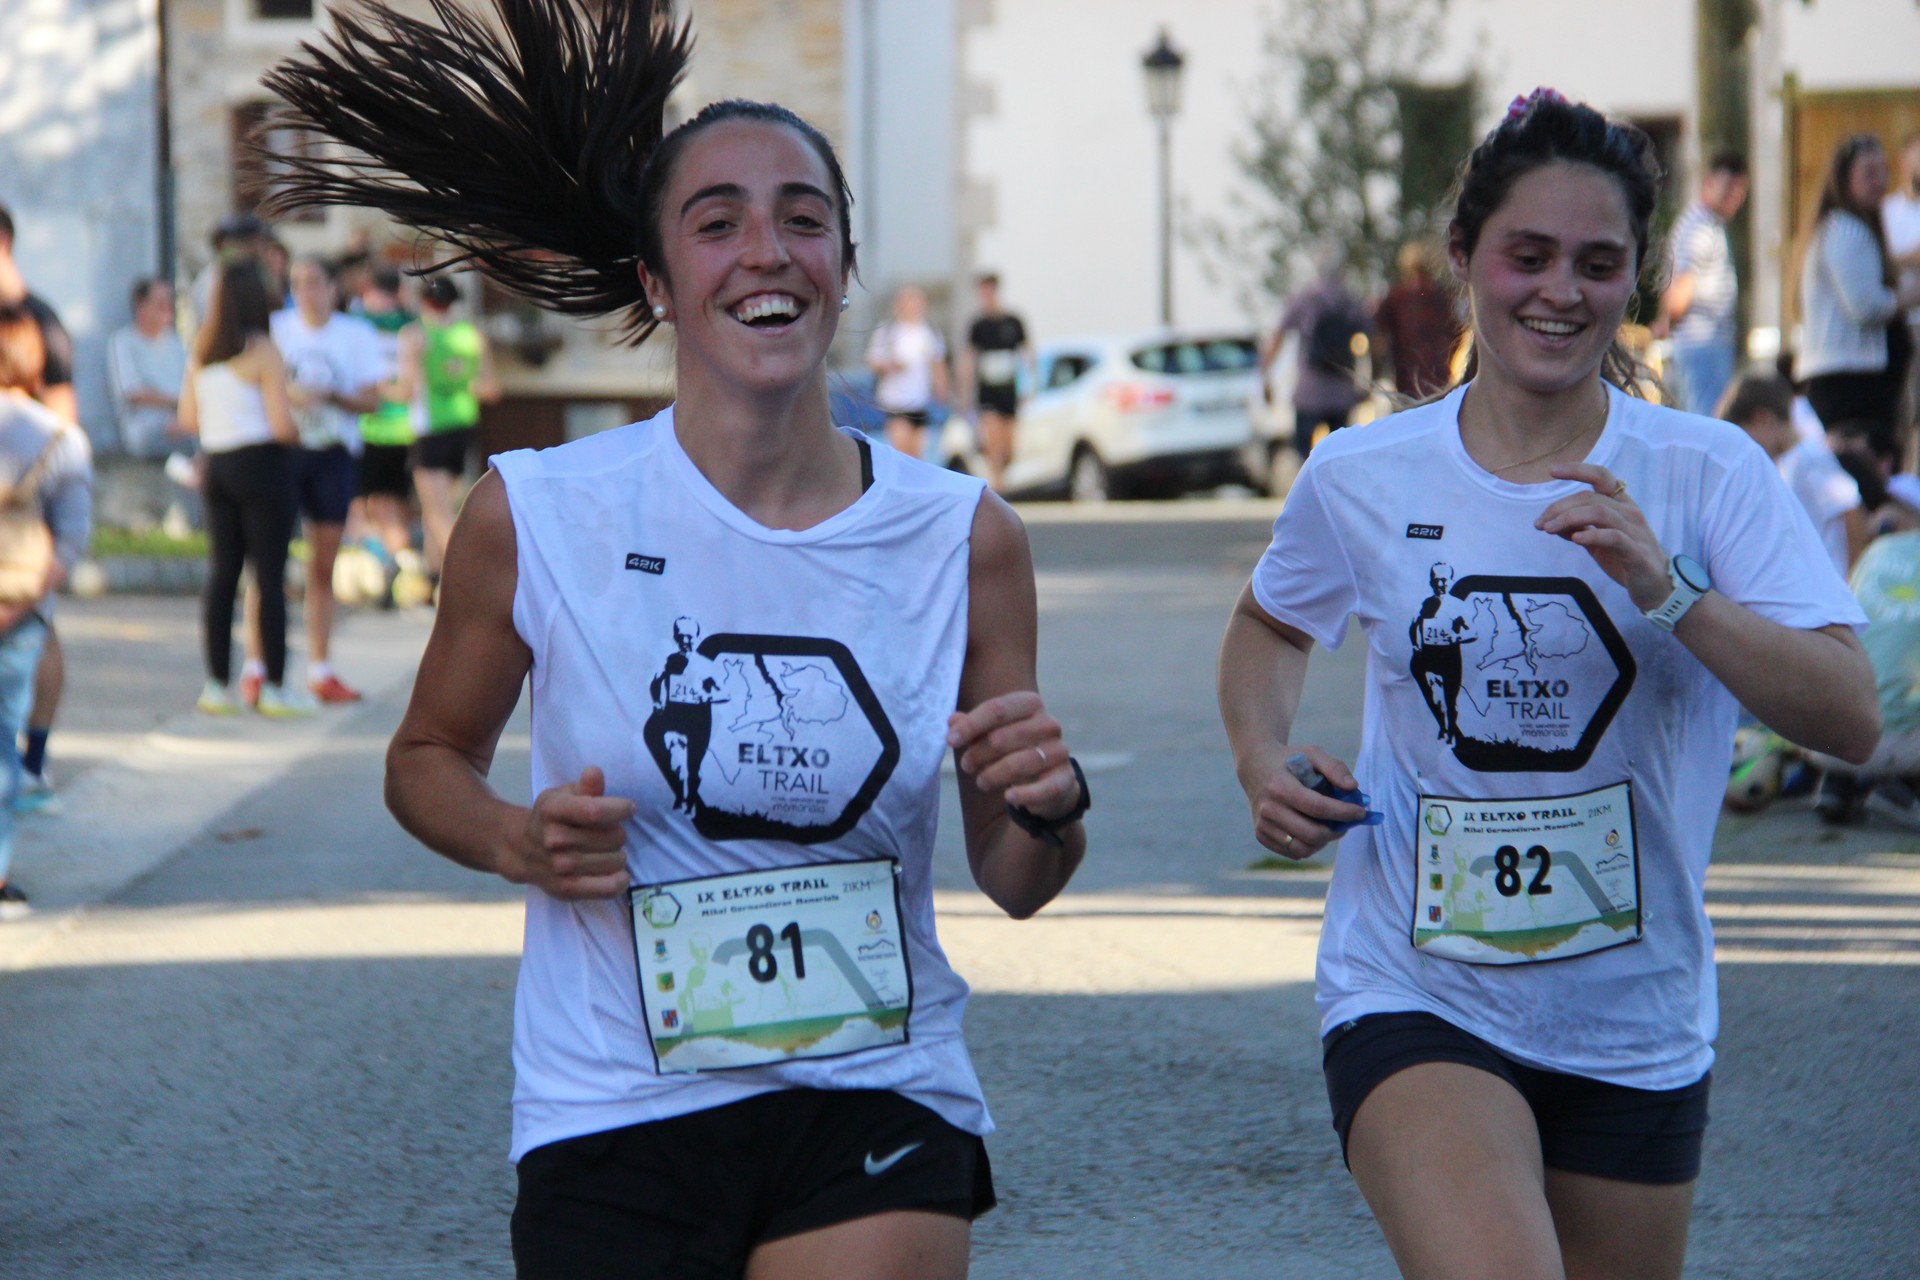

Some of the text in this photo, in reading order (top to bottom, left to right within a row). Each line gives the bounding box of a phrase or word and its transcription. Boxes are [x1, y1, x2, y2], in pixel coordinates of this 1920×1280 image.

[1409, 527, 1440, 537] 42K
[628, 557, 661, 571] 42K
[1487, 679, 1570, 699] ELTXO
[1506, 701, 1570, 719] TRAIL
[738, 742, 830, 769] ELTXO
[758, 769, 830, 795] TRAIL
[1464, 811, 1475, 822] IX
[1481, 811, 1526, 822] ELTXO
[1532, 807, 1577, 820] TRAIL
[1494, 845, 1552, 897] 82
[697, 891, 715, 903] IX
[722, 884, 775, 900] ELTXO
[781, 878, 829, 894] TRAIL
[746, 921, 806, 984] 81
